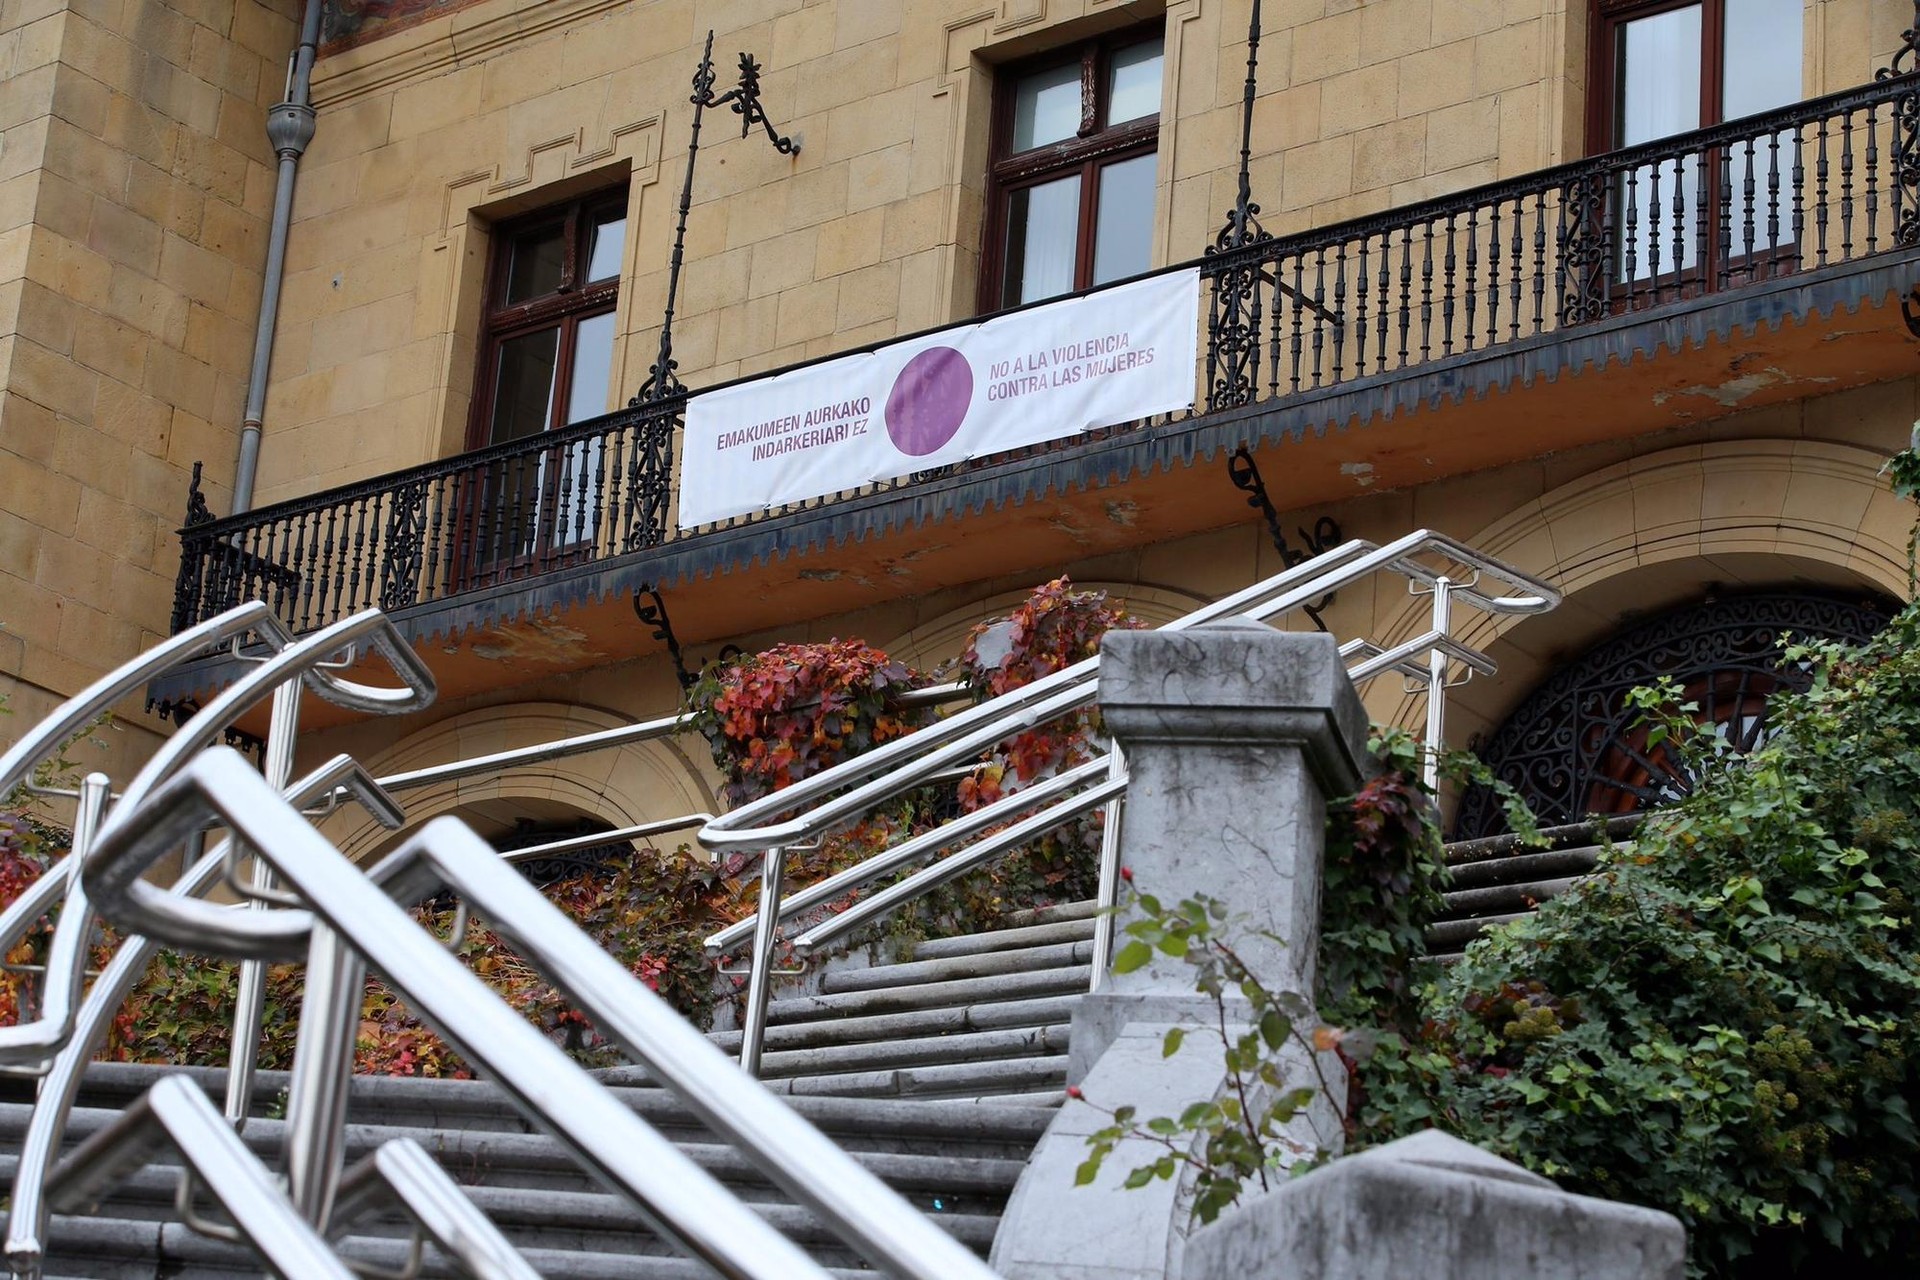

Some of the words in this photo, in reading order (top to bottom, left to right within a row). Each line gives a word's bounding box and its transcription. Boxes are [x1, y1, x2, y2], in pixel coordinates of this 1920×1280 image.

[987, 374, 1047, 401] CONTRA
[1052, 365, 1081, 387] LAS
[1085, 347, 1155, 379] MUJERES
[989, 361, 1009, 380] NO
[1013, 357, 1023, 374] A
[1028, 351, 1048, 371] LA
[1052, 332, 1129, 365] VIOLENCIA
[717, 414, 800, 450] EMAKUMEEN
[803, 397, 870, 427] AURKAKO
[752, 423, 849, 461] INDARKERIARI
[852, 418, 869, 436] EZ
